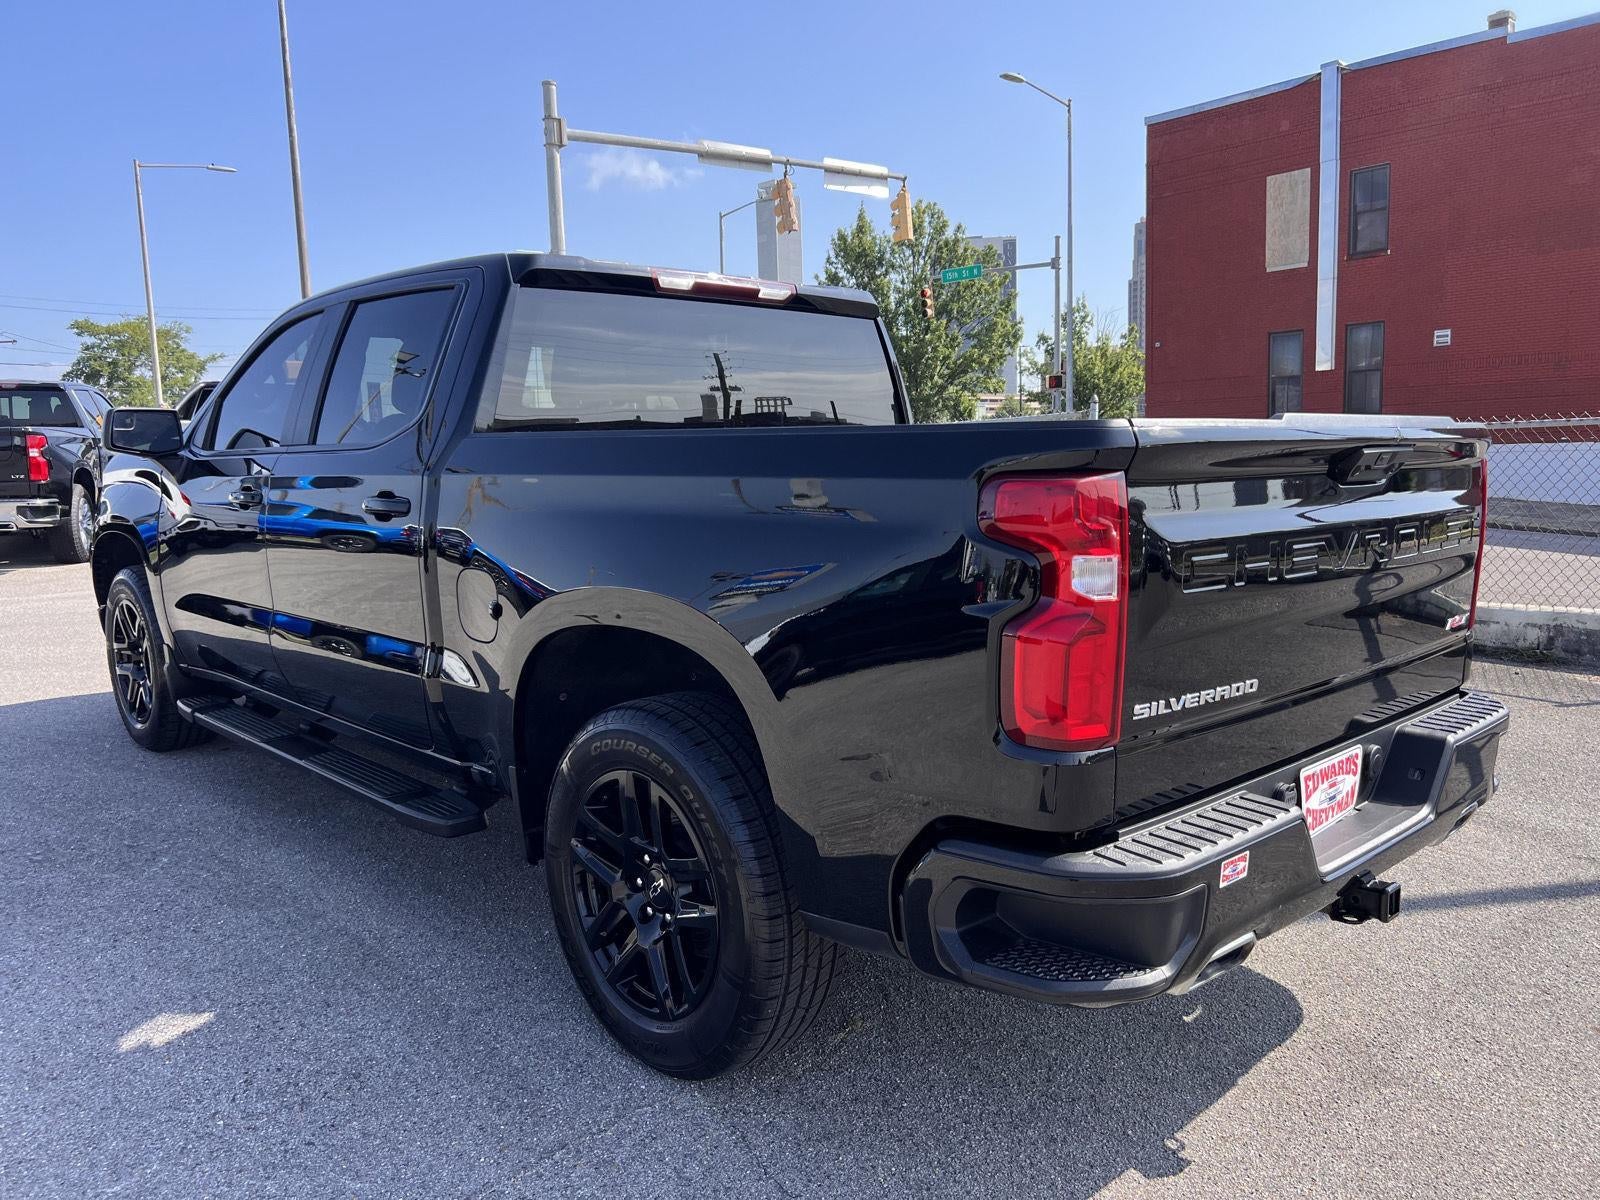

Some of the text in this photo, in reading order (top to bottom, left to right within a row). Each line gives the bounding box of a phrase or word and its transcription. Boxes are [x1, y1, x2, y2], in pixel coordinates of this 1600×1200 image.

[946, 271, 958, 280] 15th
[1132, 678, 1259, 720] SILVERADO
[590, 738, 675, 777] COURSER
[1303, 752, 1359, 804] EDWARDS
